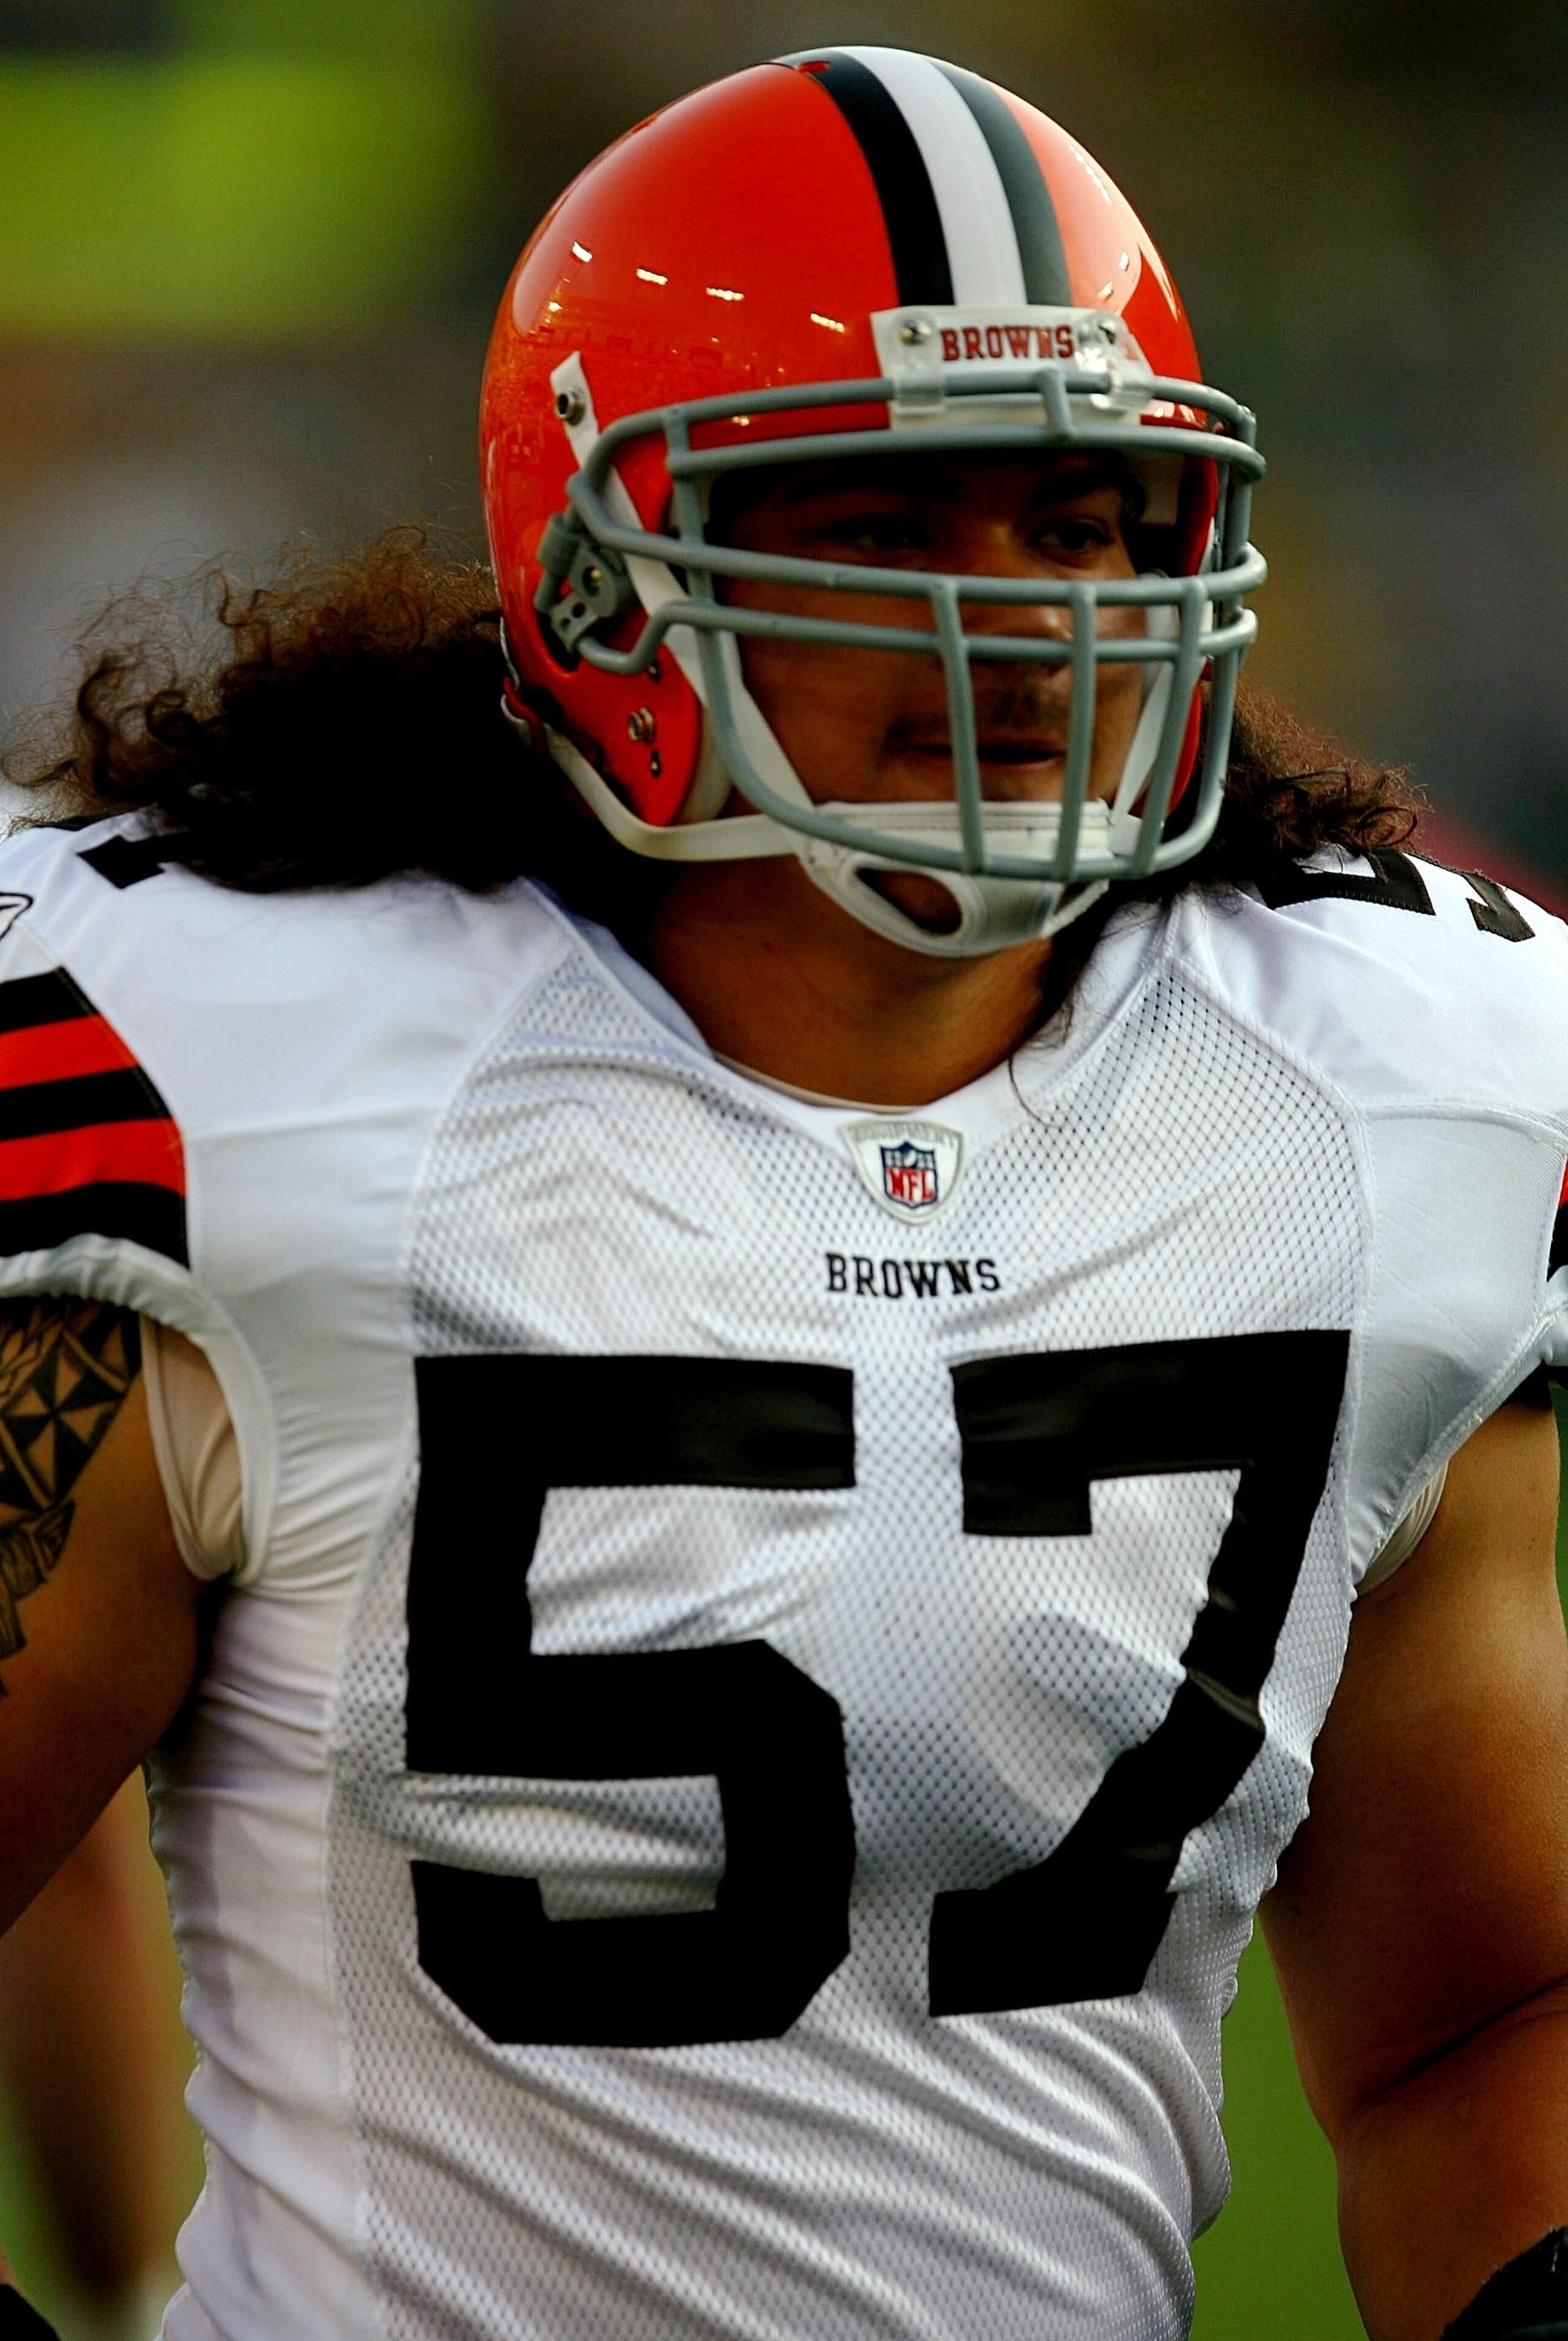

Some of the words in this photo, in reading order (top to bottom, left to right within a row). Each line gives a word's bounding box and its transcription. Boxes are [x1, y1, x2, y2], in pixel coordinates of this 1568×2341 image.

[940, 325, 1074, 361] BROWNS
[888, 1167, 935, 1202] NFL
[826, 1252, 1000, 1298] BROWNS
[405, 1329, 1351, 2048] 57
